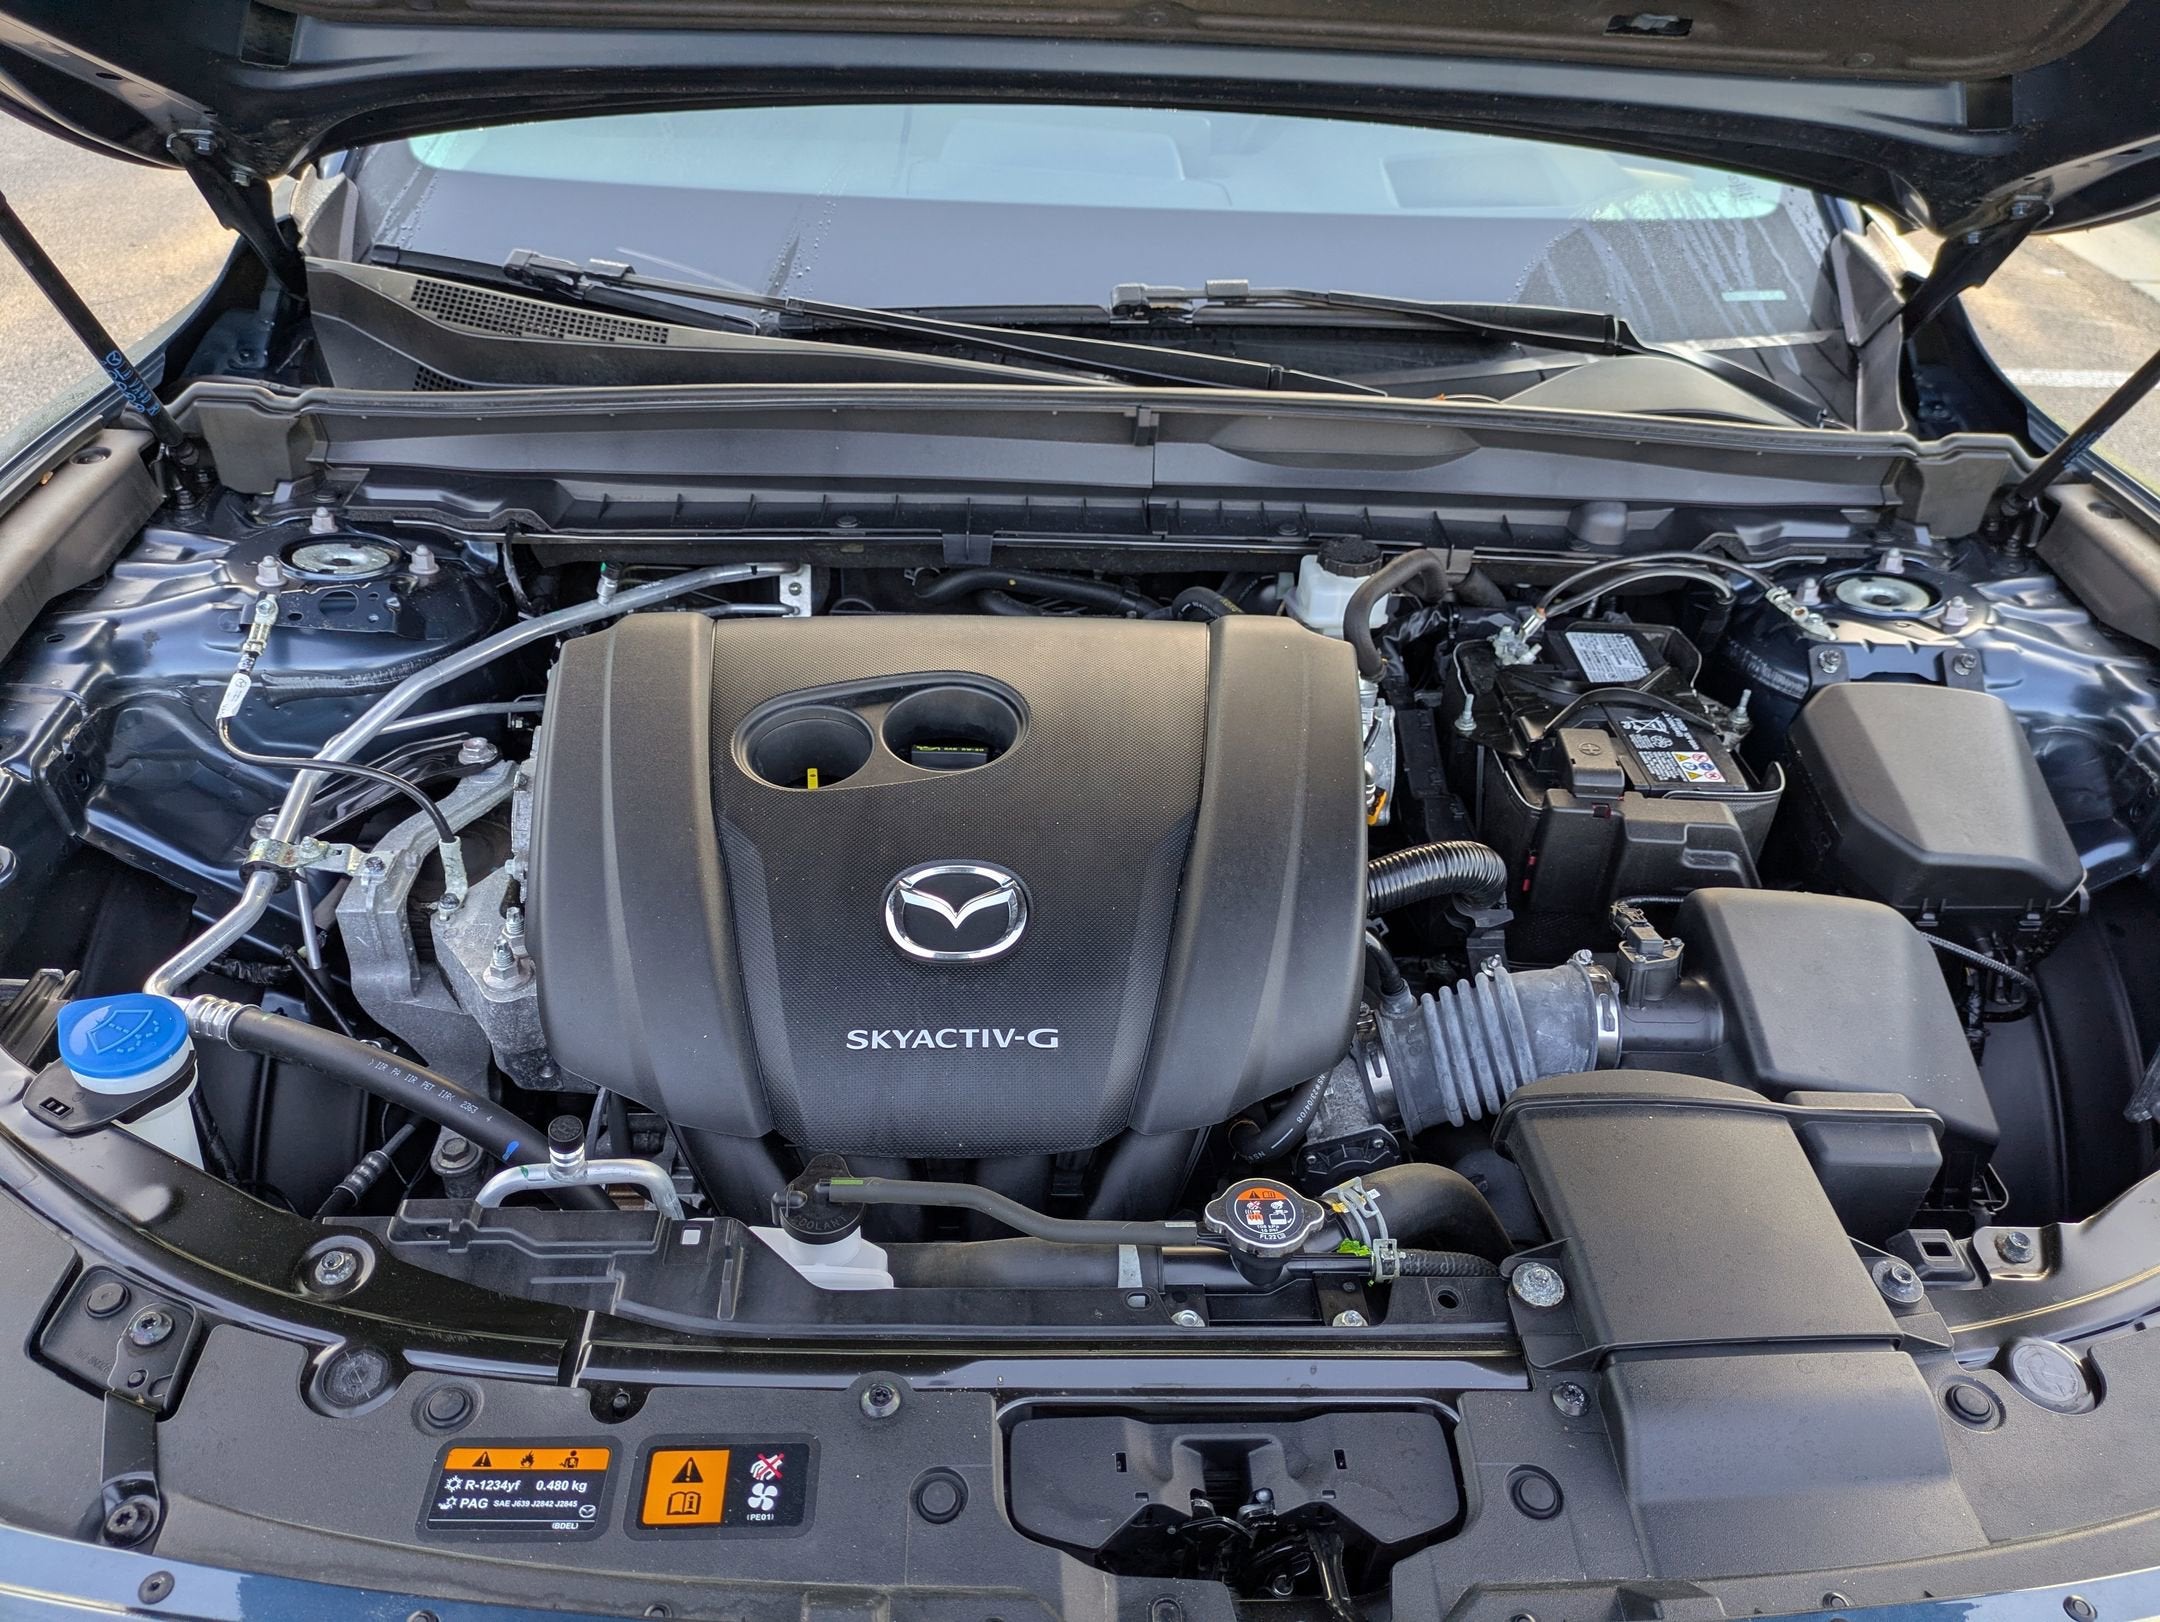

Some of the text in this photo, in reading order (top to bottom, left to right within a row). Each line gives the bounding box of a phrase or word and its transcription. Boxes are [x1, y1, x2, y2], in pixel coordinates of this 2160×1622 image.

[846, 1028, 1059, 1050] SKYACTIV-G
[464, 1480, 588, 1493] R-1234yf 0.480 kg
[459, 1498, 489, 1509] PAG
[511, 1500, 530, 1508] J639
[531, 1500, 554, 1508] J2842
[554, 1500, 578, 1508] J2845
